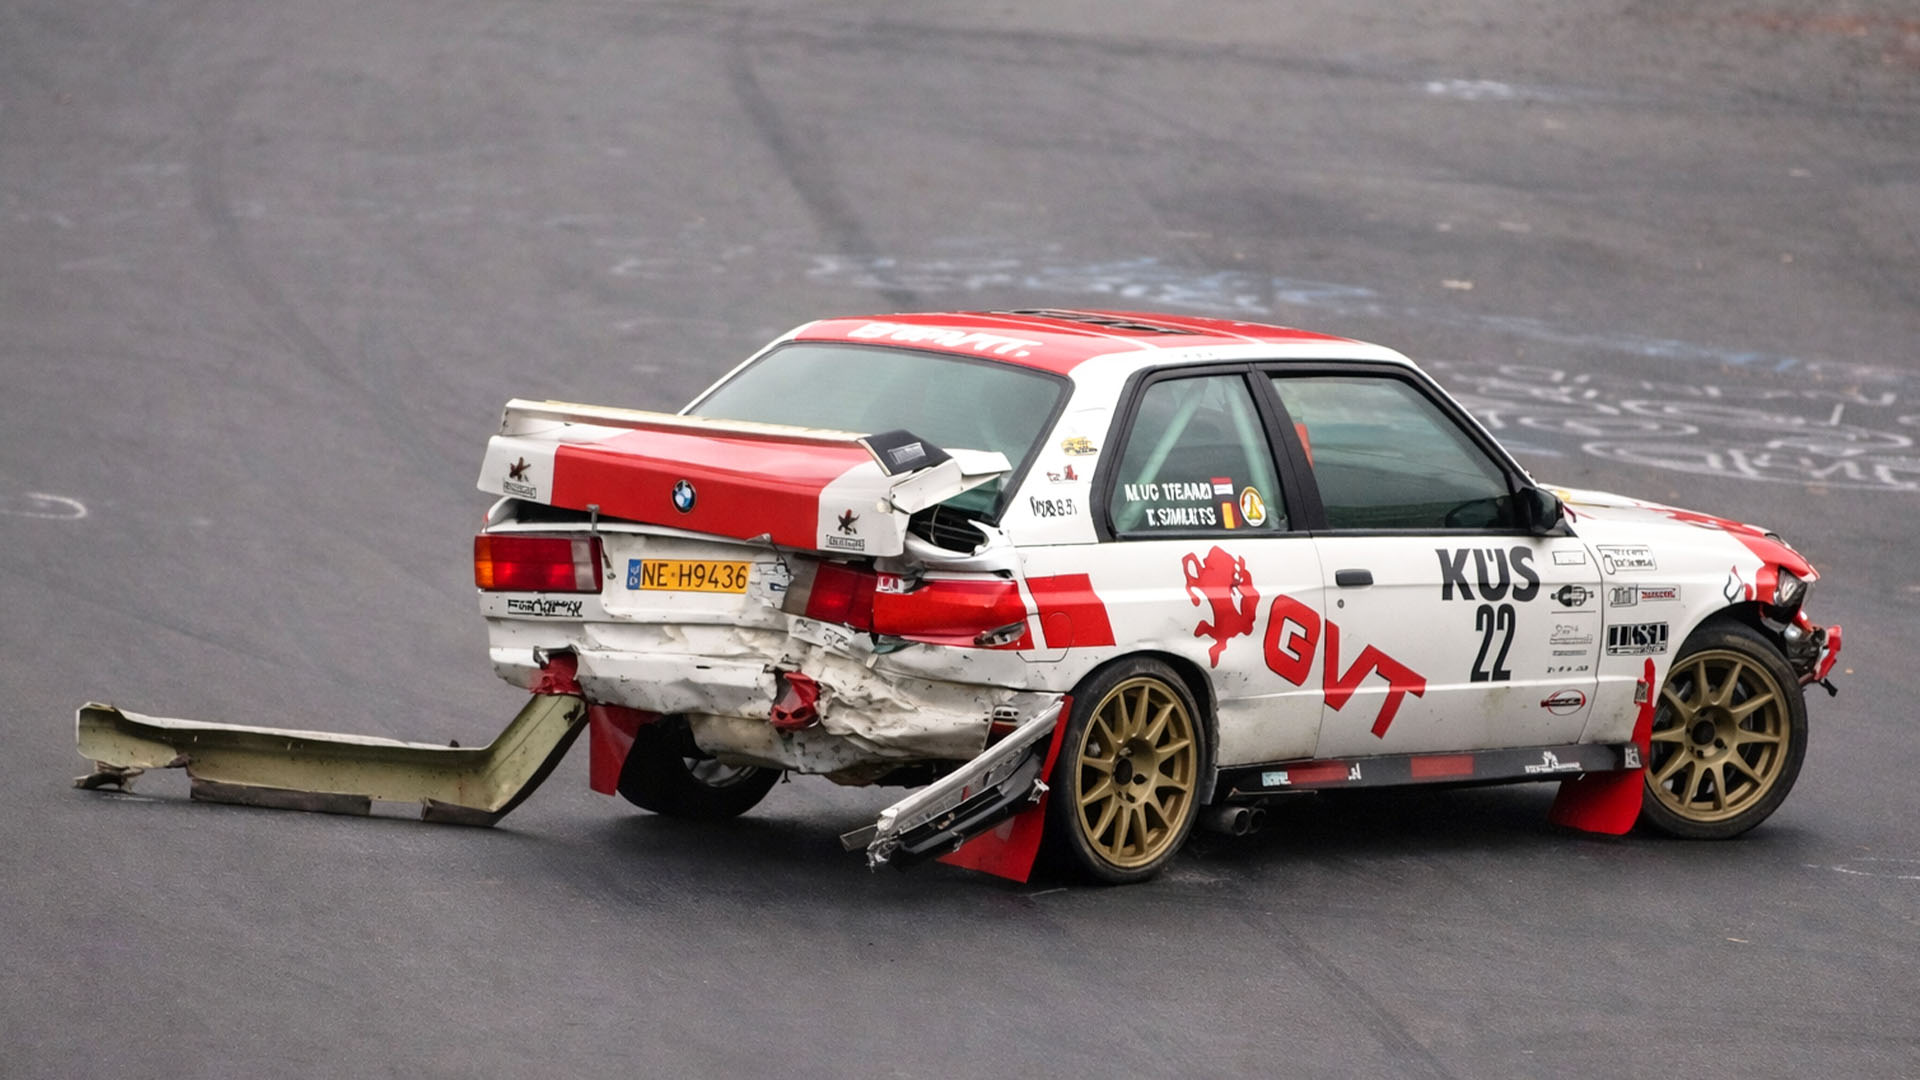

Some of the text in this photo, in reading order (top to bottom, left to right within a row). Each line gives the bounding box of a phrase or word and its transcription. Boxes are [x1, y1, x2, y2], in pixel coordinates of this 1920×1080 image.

[1435, 546, 1540, 602] KÜS
[1263, 594, 1427, 740] GVT
[1470, 603, 1516, 683] 22
